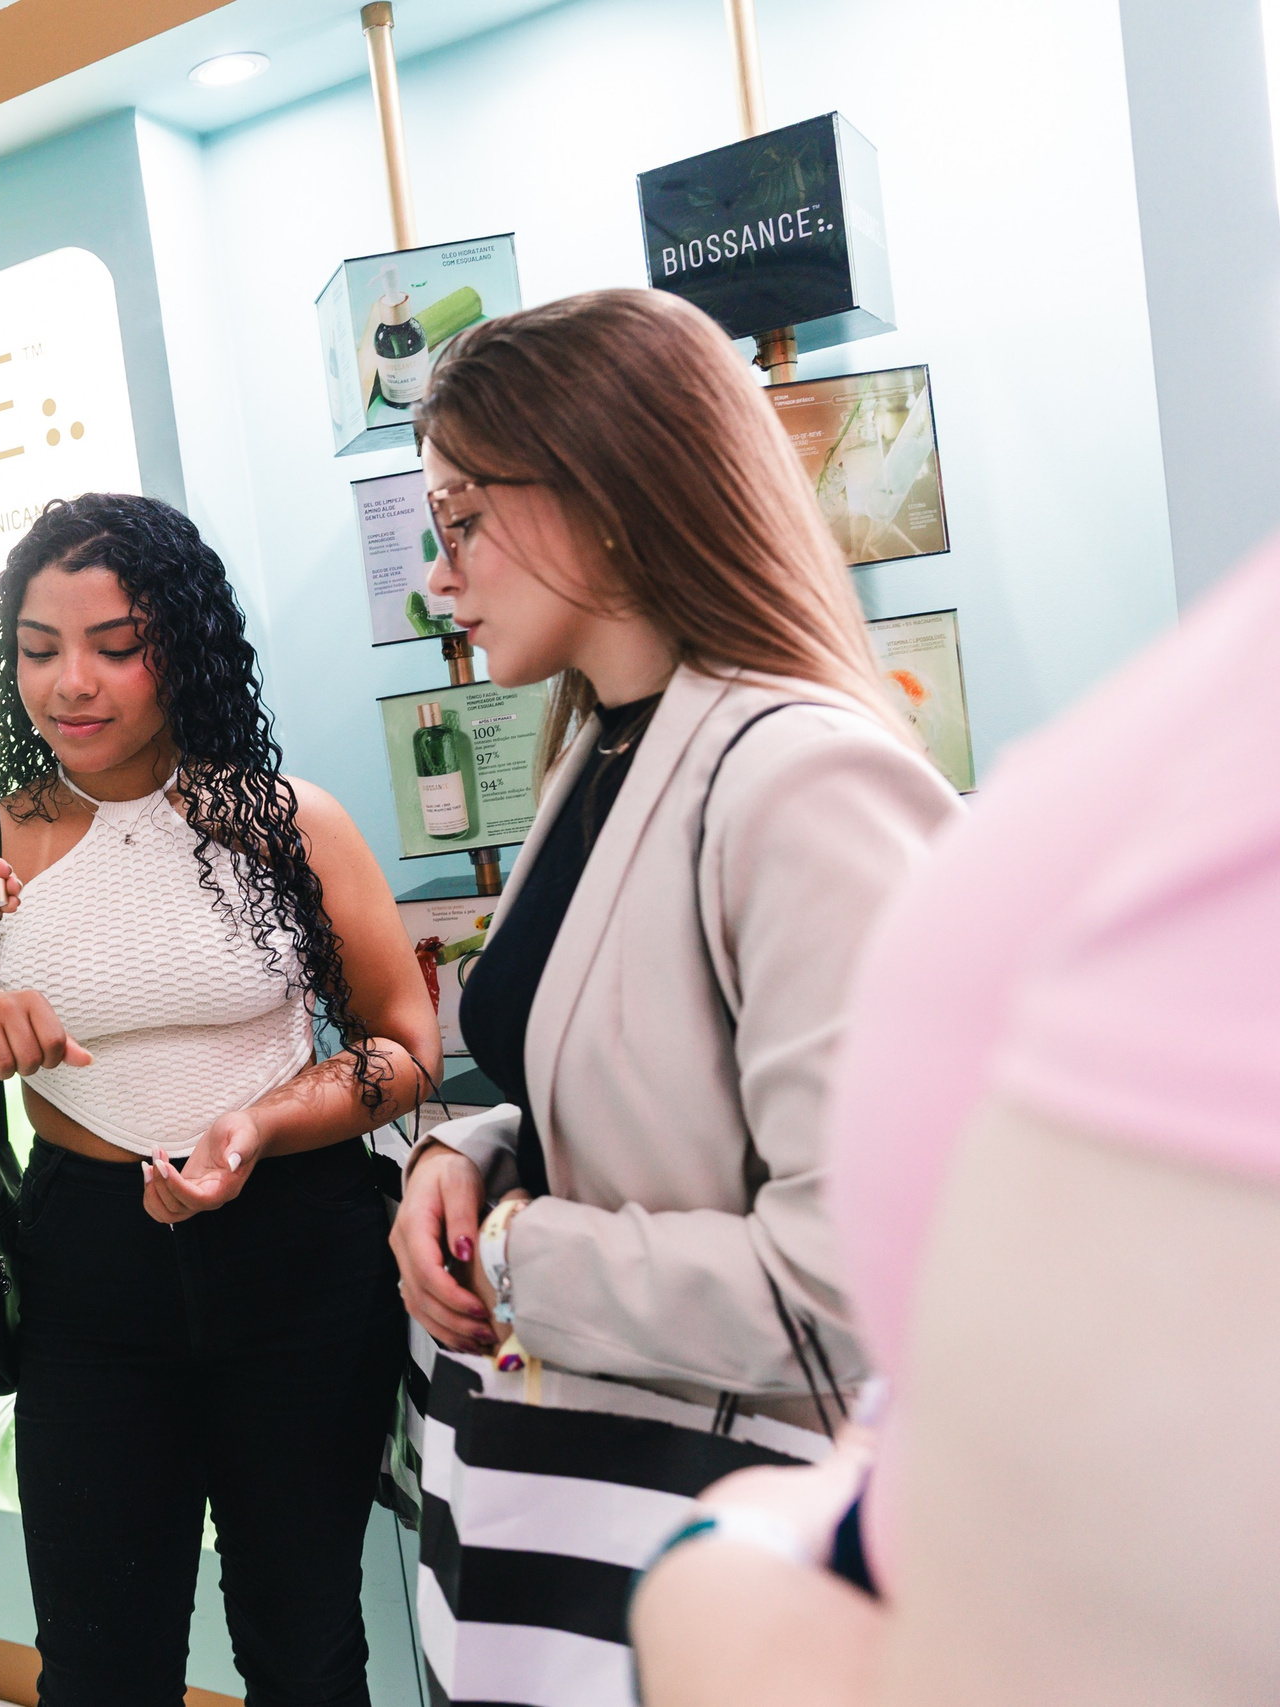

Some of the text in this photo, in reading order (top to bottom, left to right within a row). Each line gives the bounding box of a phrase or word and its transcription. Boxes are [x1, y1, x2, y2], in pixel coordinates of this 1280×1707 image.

[662, 206, 813, 276] BIOSSANCE
[458, 246, 495, 256] HIDRATANTE
[442, 254, 492, 267] COM ESQUALANO
[382, 497, 406, 505] LIMPEZA
[364, 507, 381, 515] AMINO
[365, 508, 415, 521] GENTLE CLEANSER
[478, 701, 505, 710] ESQUALANO
[472, 725, 502, 740] 100%
[476, 751, 500, 765] 97%
[480, 778, 505, 793] 94%
